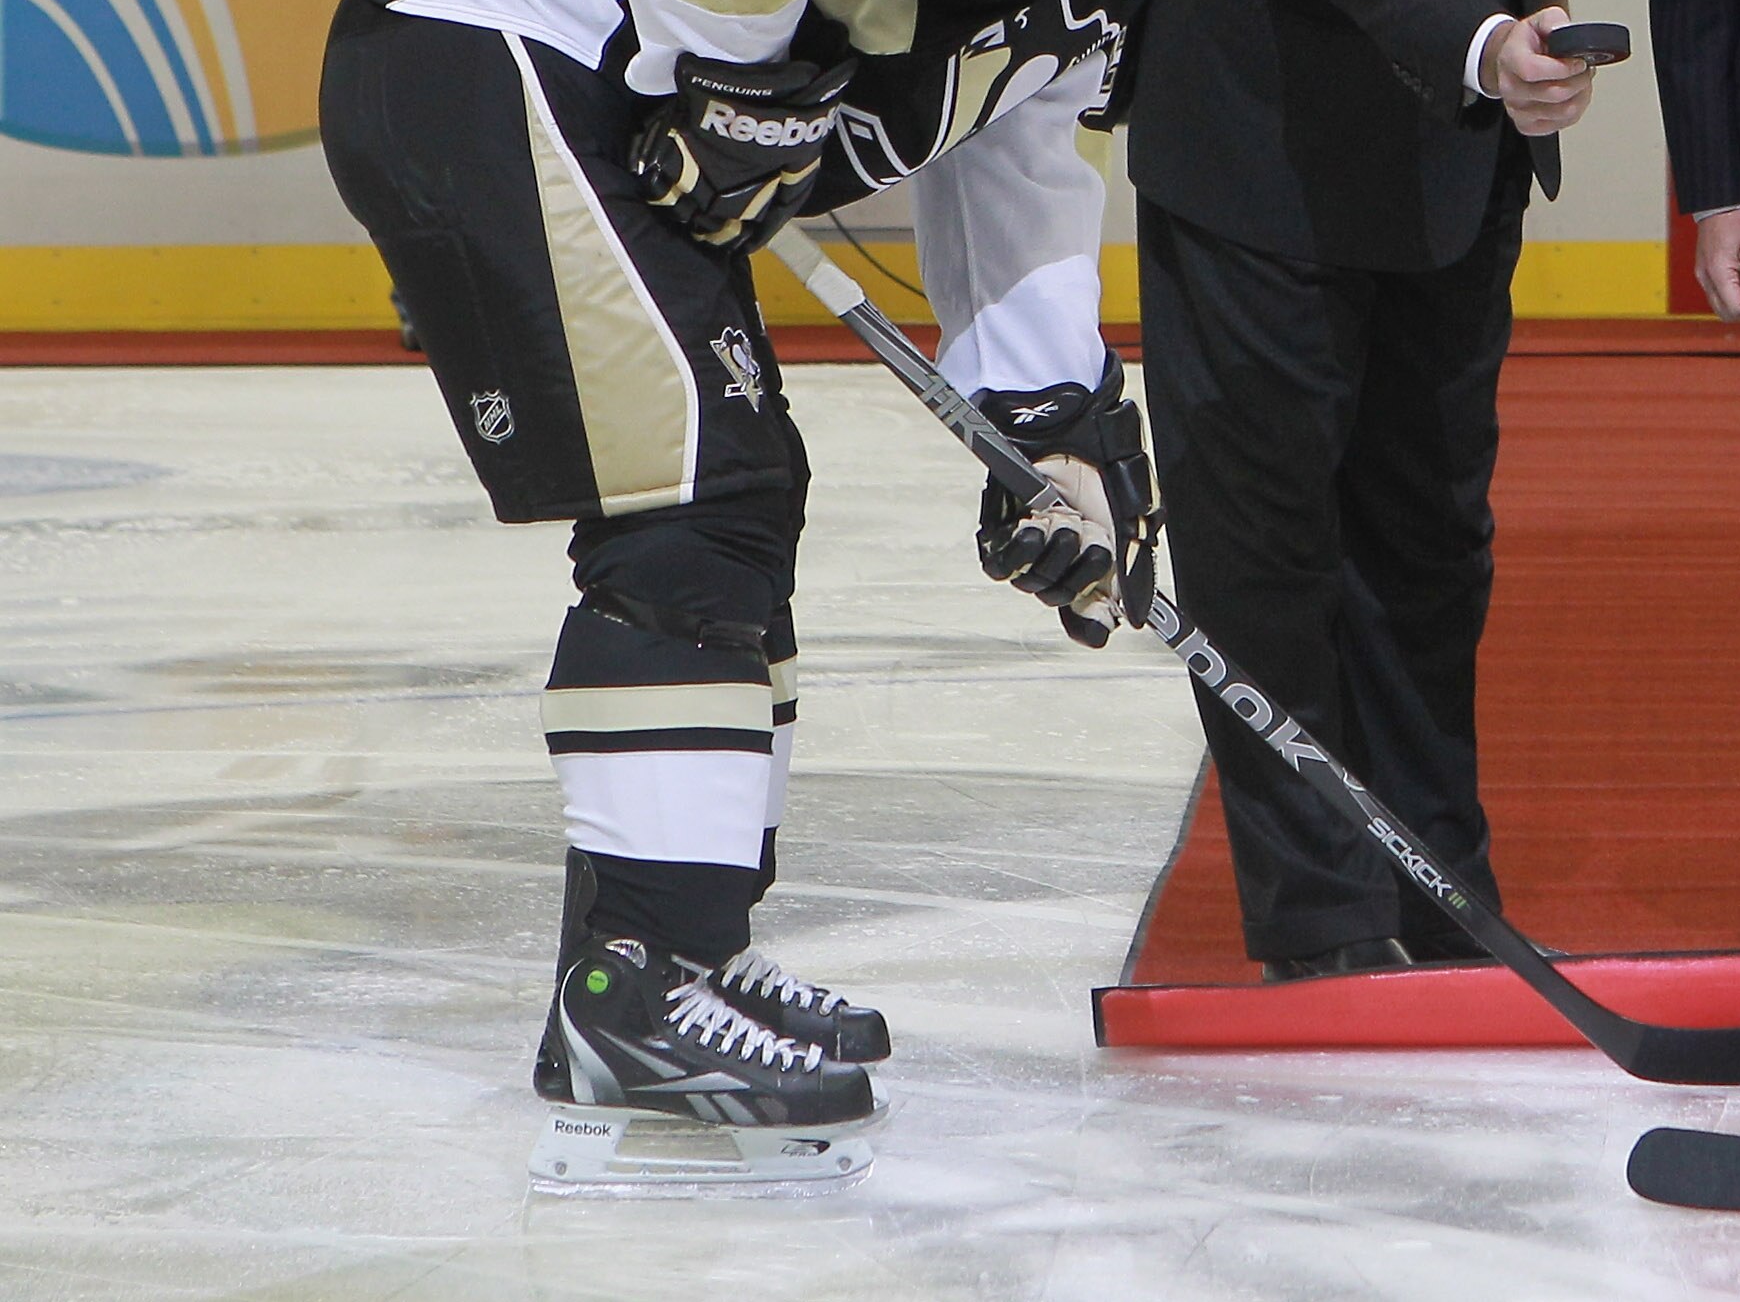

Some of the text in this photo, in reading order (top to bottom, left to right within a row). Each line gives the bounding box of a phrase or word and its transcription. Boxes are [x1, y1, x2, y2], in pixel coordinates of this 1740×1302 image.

[691, 75, 773, 96] PENGUINS
[1366, 816, 1452, 898] SICKICK
[553, 1119, 612, 1137] Reebok
